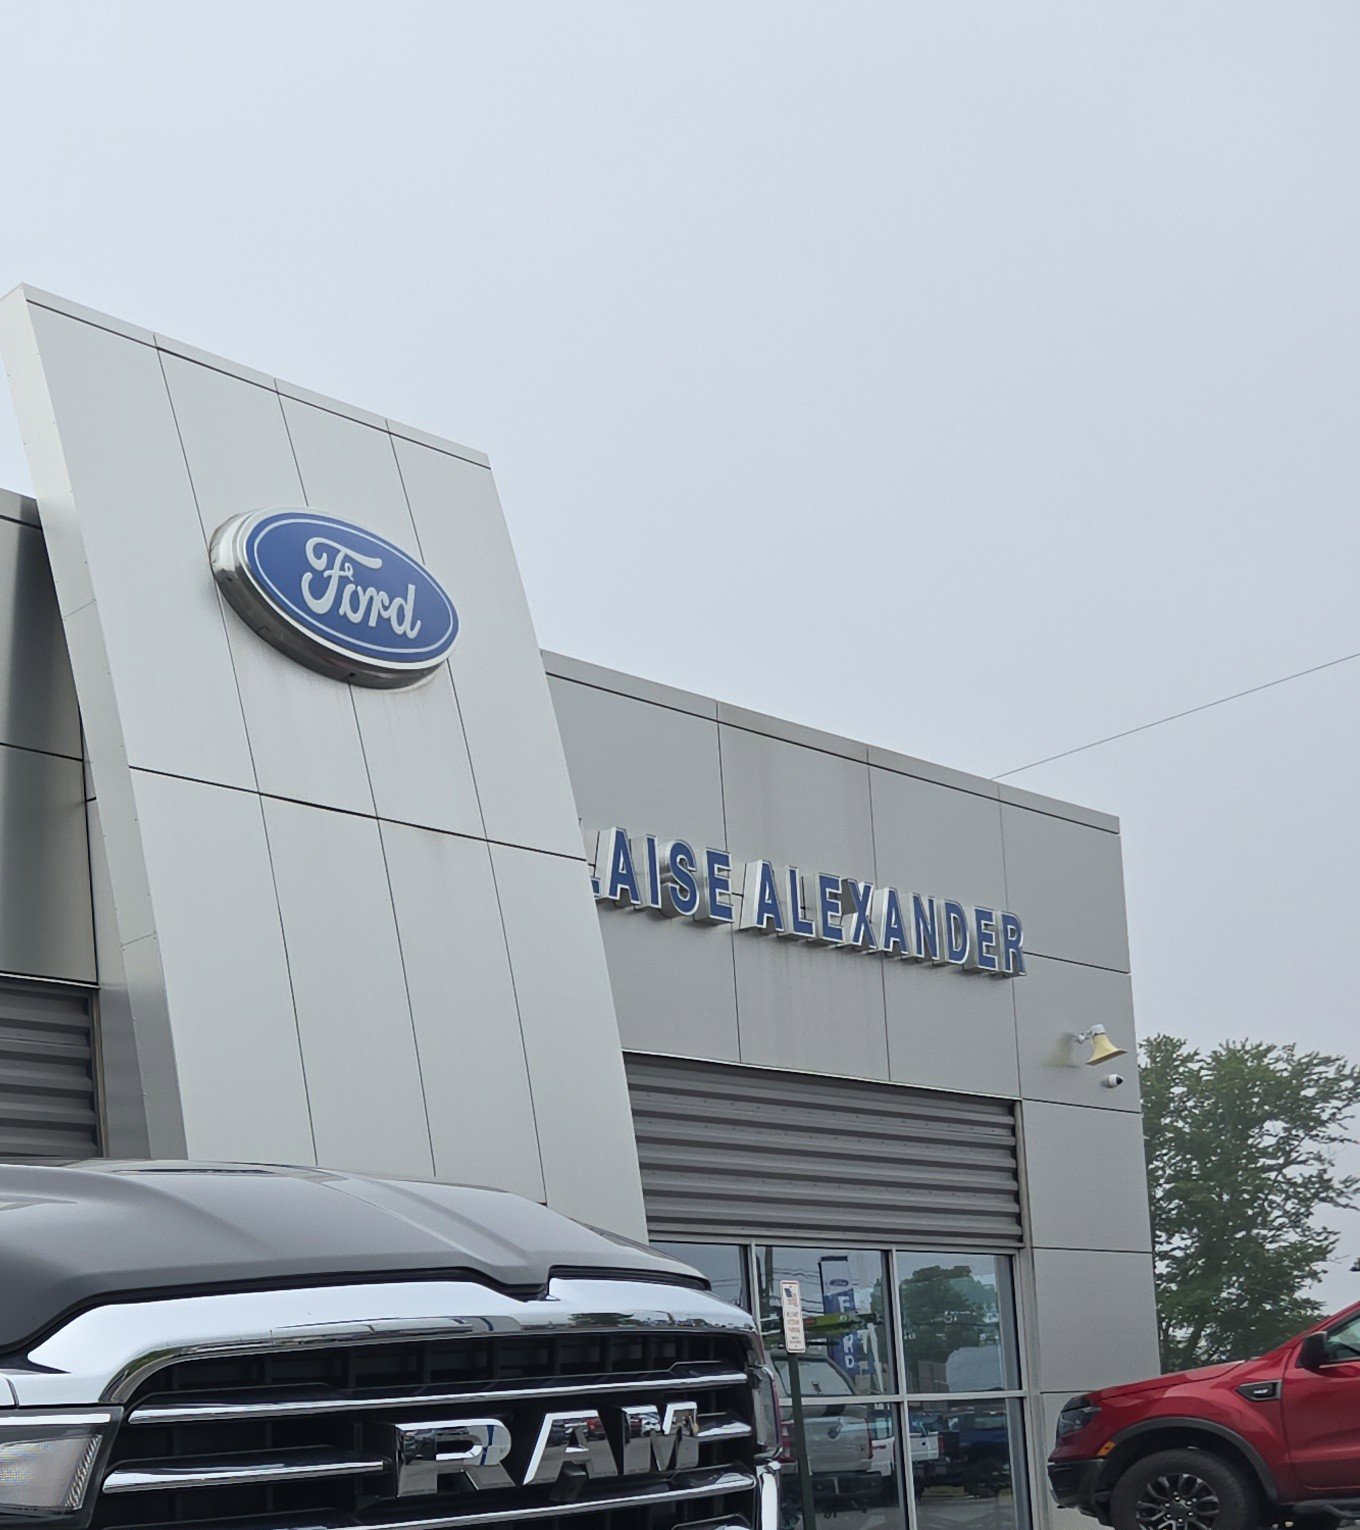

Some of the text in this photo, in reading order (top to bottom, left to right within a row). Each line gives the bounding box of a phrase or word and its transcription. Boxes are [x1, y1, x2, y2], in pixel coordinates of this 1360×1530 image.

[300, 537, 422, 639] Ford
[590, 826, 1027, 977] AISE ALEXANDER
[837, 1295, 856, 1369] FRD
[394, 1401, 700, 1498] RAM
